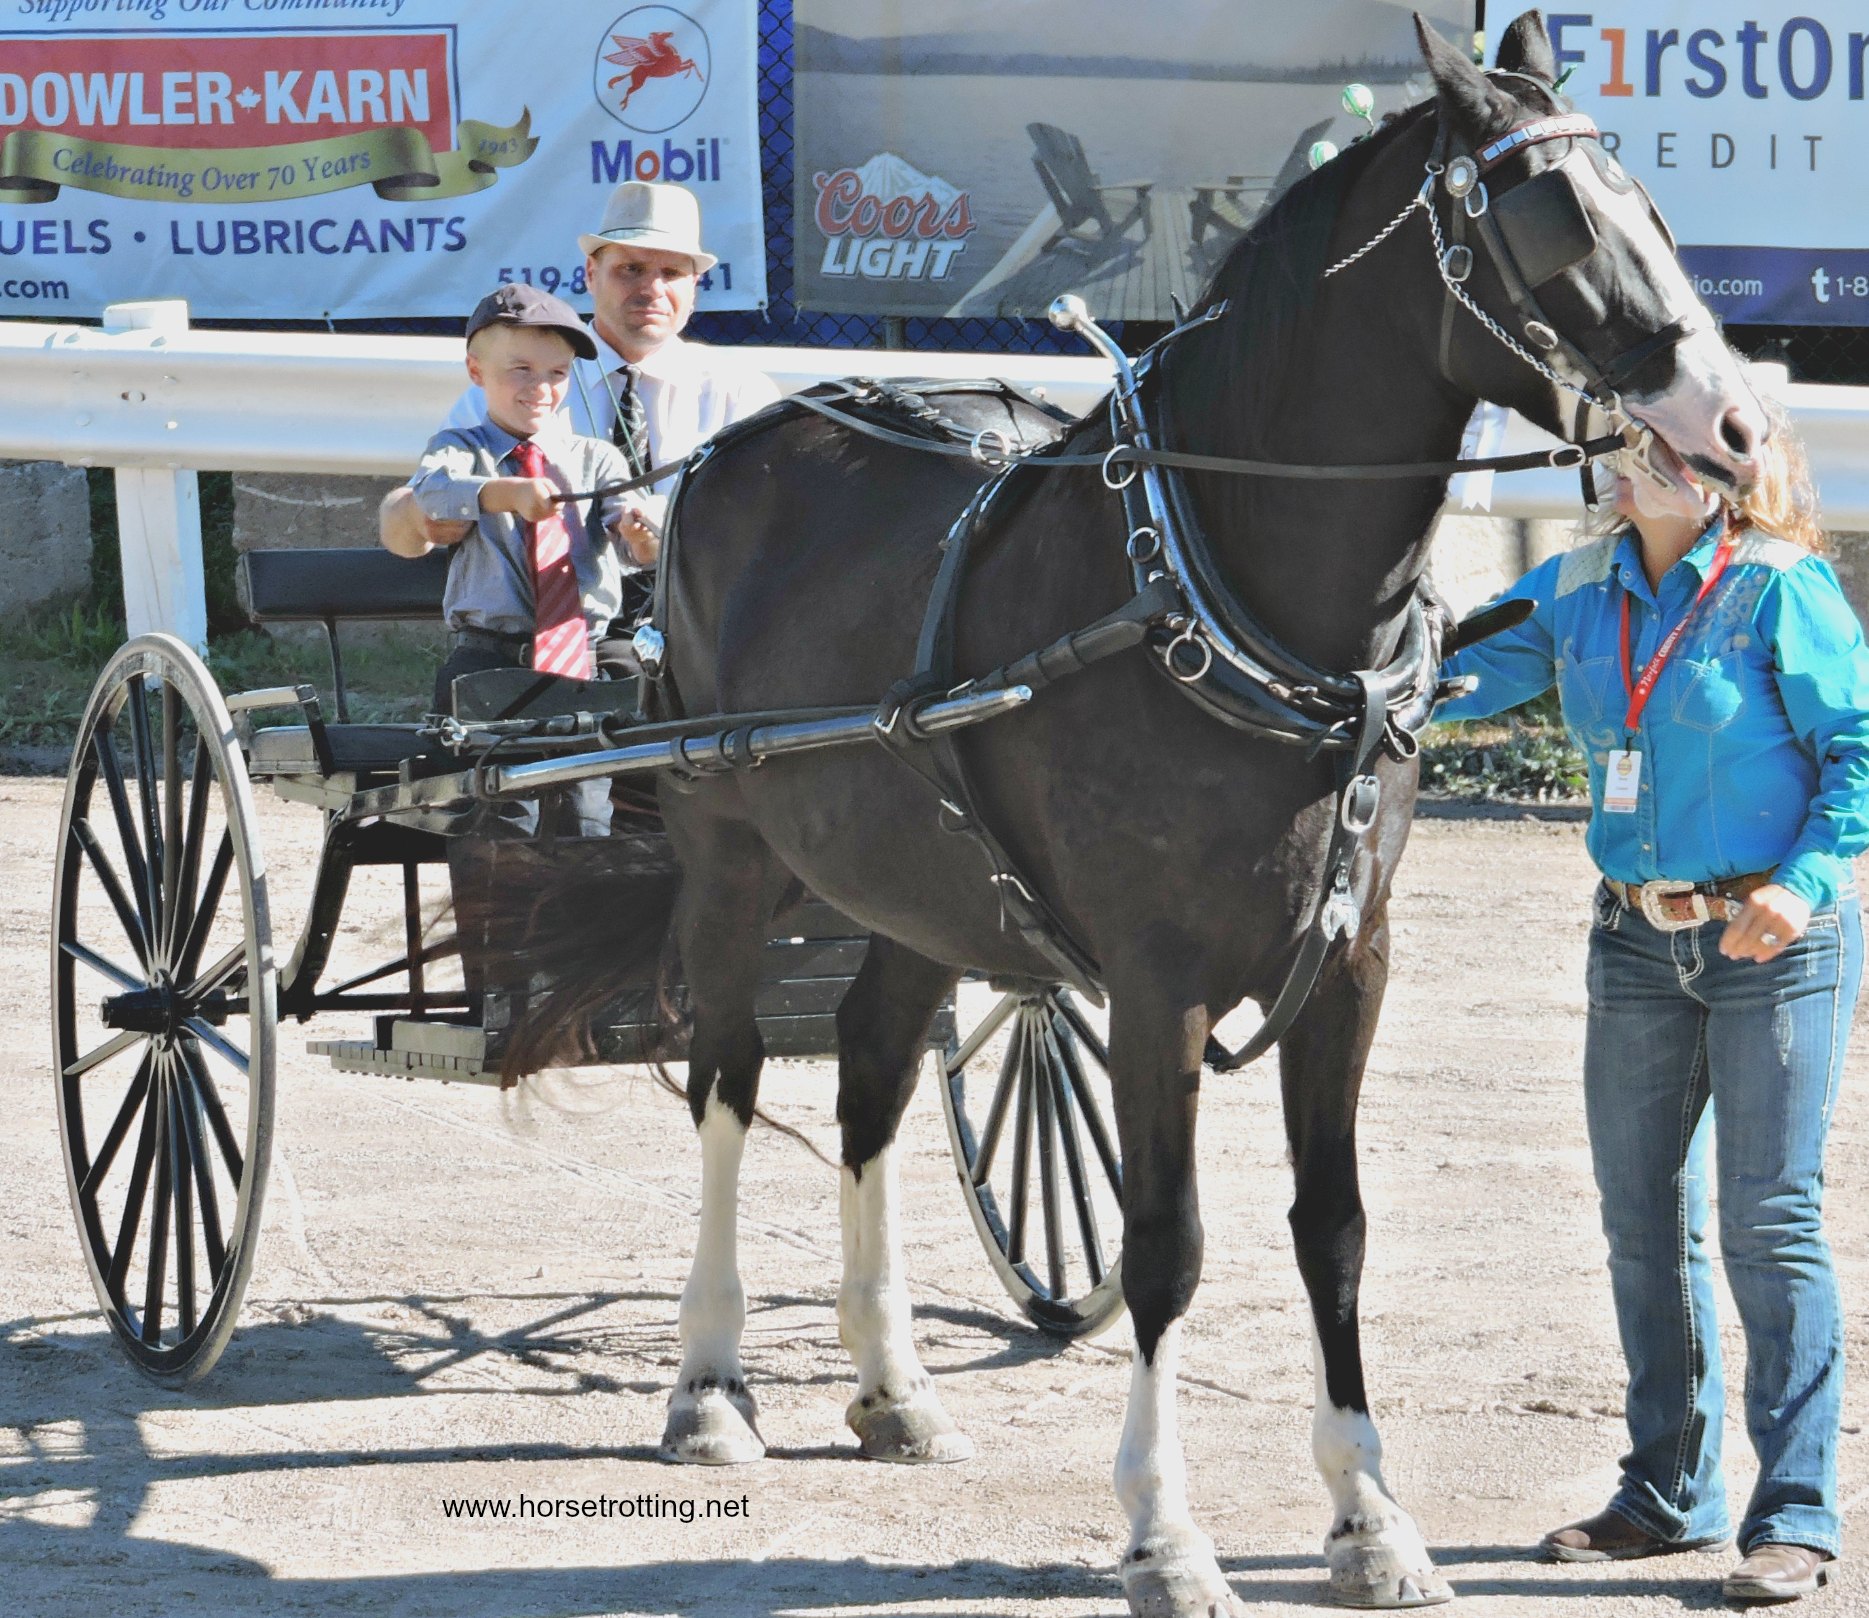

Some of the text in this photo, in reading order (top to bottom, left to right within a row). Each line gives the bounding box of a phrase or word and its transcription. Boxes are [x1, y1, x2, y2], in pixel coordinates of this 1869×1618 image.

[0, 68, 431, 126] DOWLER KARN
[52, 148, 371, 197] Celebrating Over 70 Years
[591, 137, 720, 183] Mobil
[813, 168, 978, 241] Coors
[0, 216, 467, 255] UELS LUBRICANTS
[820, 236, 968, 281] LIGHT
[1688, 273, 1763, 296] io.com
